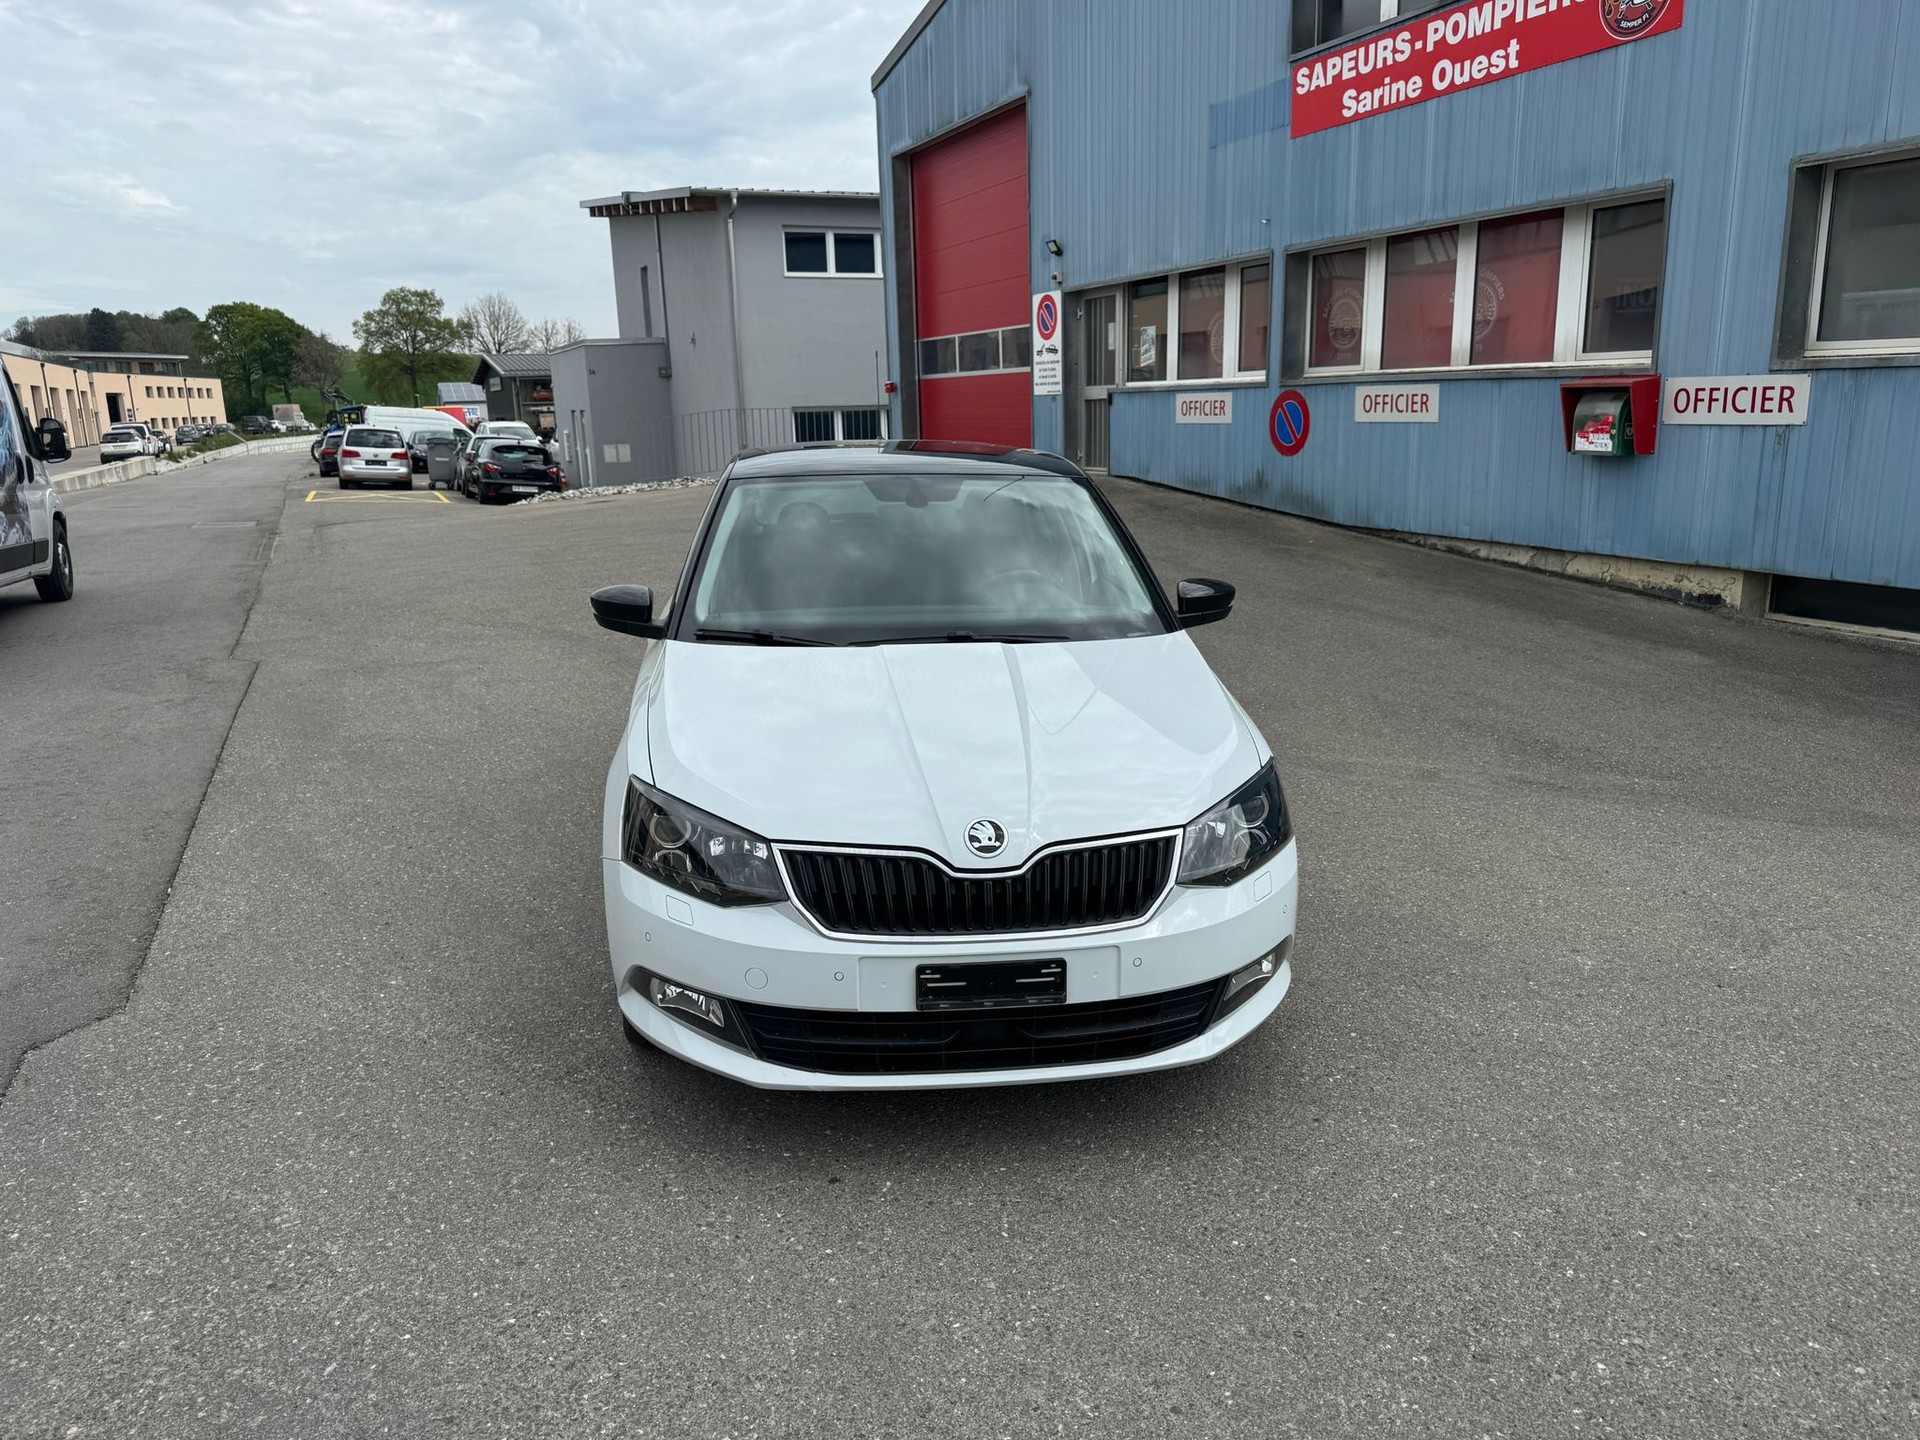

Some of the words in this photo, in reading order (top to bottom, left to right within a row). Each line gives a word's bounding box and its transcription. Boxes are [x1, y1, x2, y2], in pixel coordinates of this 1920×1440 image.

[1341, 76, 1422, 118] Sarine
[1431, 38, 1520, 91] Ouest
[1180, 399, 1226, 417] OFFICIER
[1362, 393, 1430, 414] OFFICIER
[1673, 385, 1796, 414] OFFICIER
